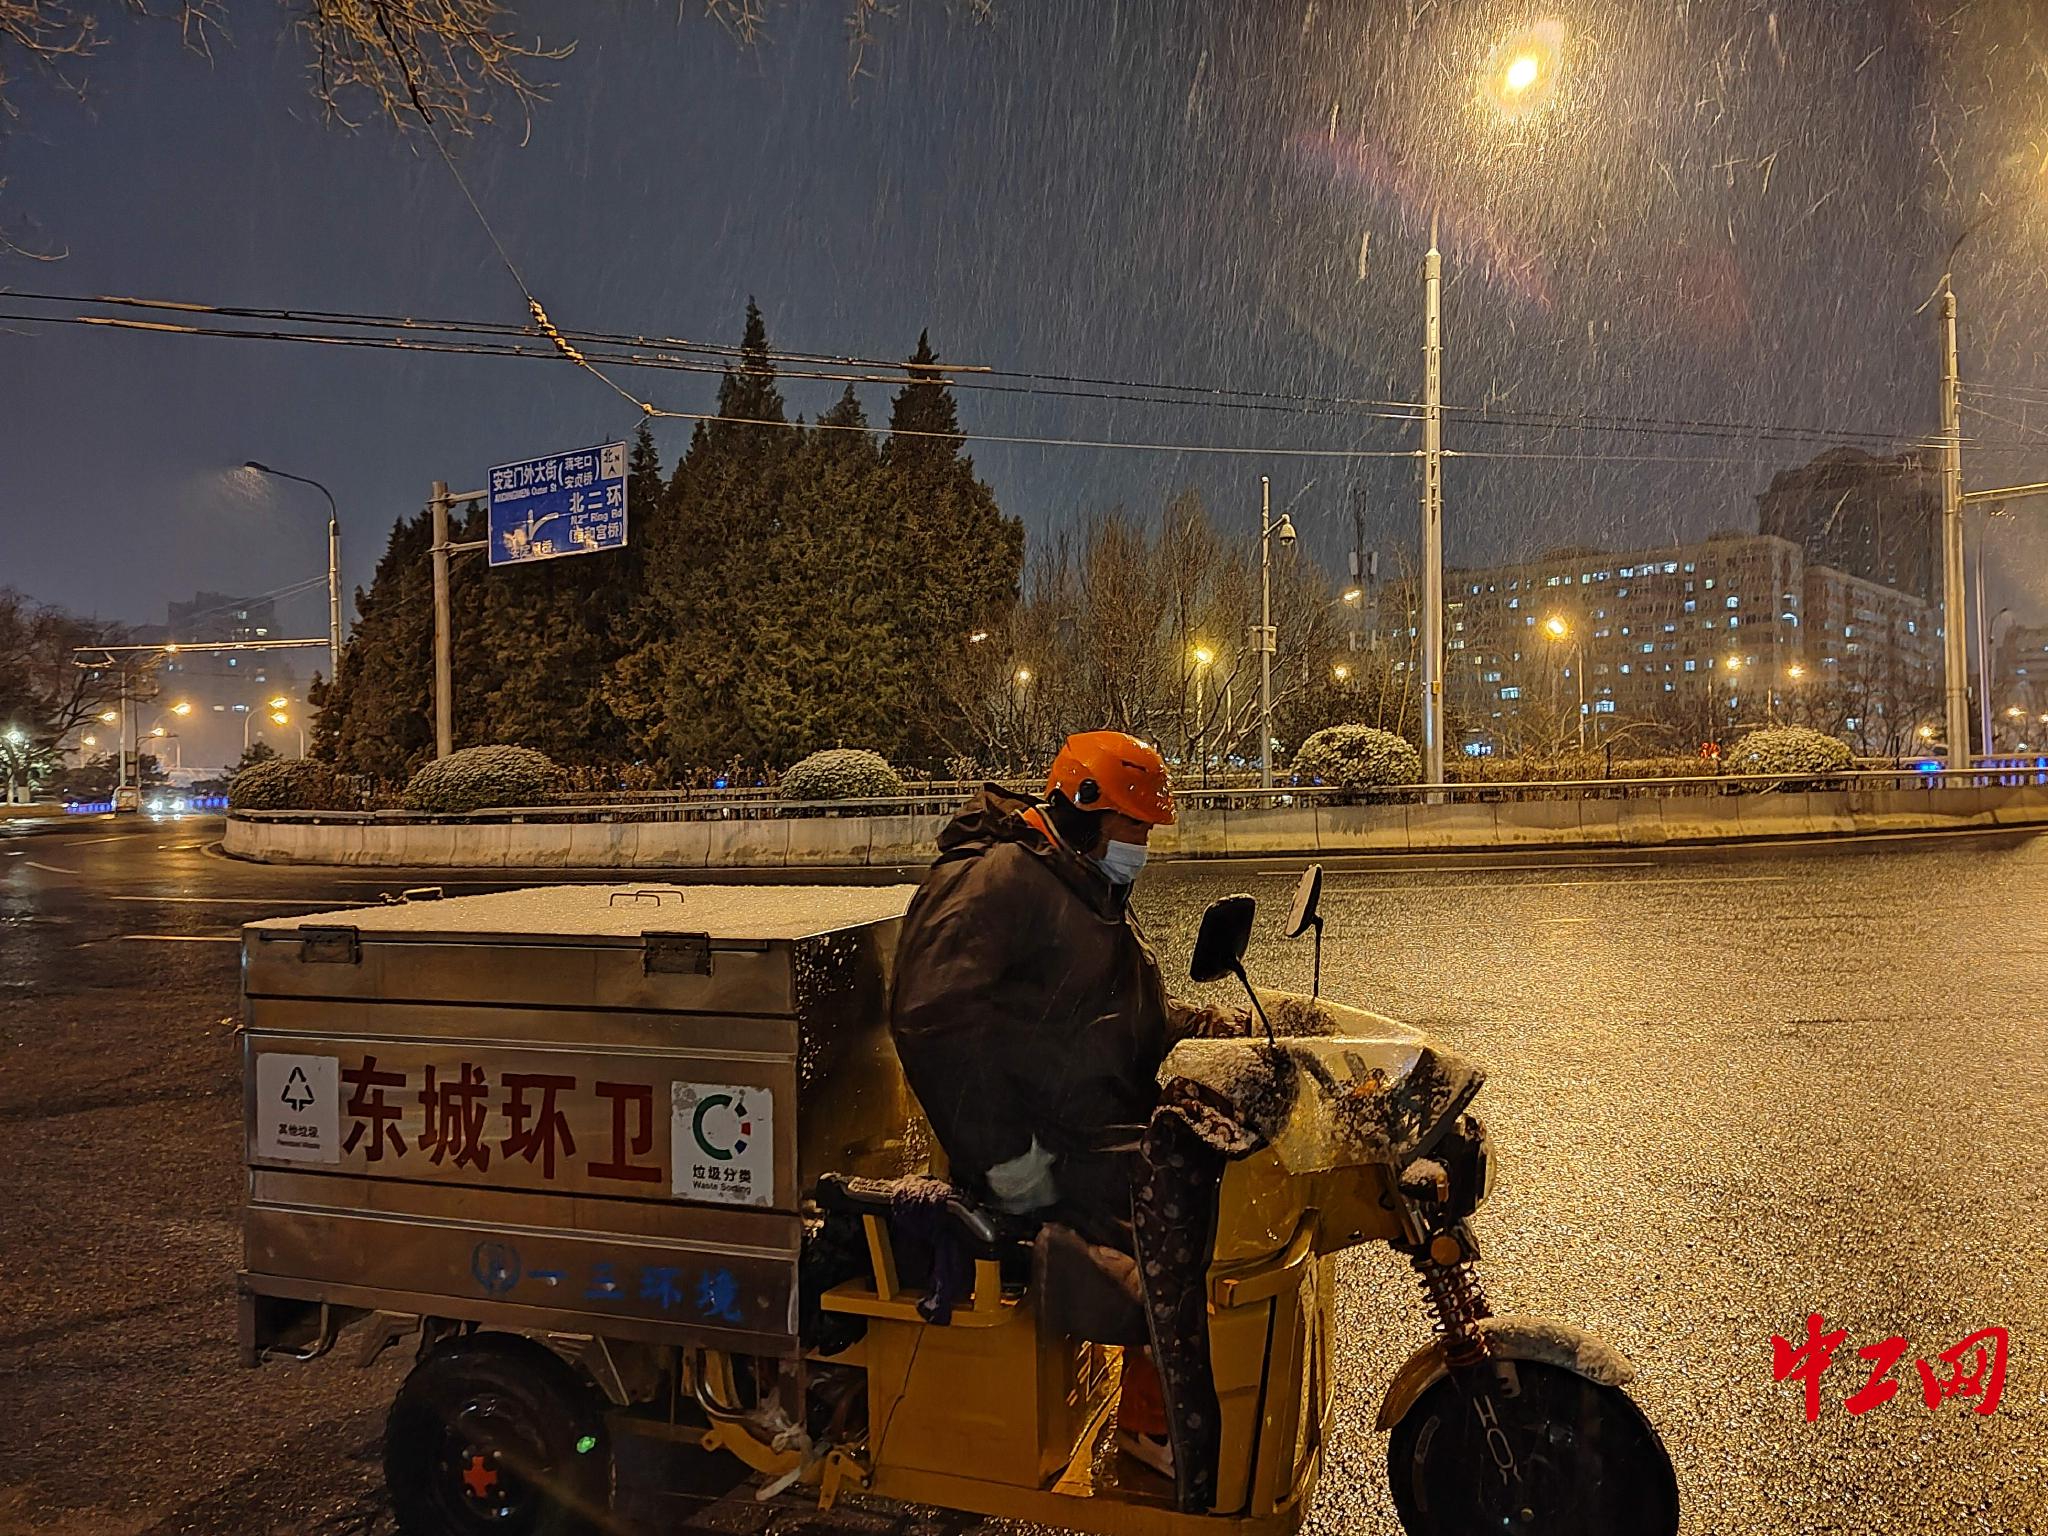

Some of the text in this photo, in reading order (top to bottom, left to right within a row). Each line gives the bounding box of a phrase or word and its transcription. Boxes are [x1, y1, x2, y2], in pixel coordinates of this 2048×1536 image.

[603, 449, 613, 464] 北
[493, 459, 557, 491] 安定门外大街
[569, 484, 622, 514] 北二环
[342, 1055, 662, 1183] 东城环卫
[693, 1164, 751, 1183] 垃圾分类
[693, 1180, 718, 1190] Waste
